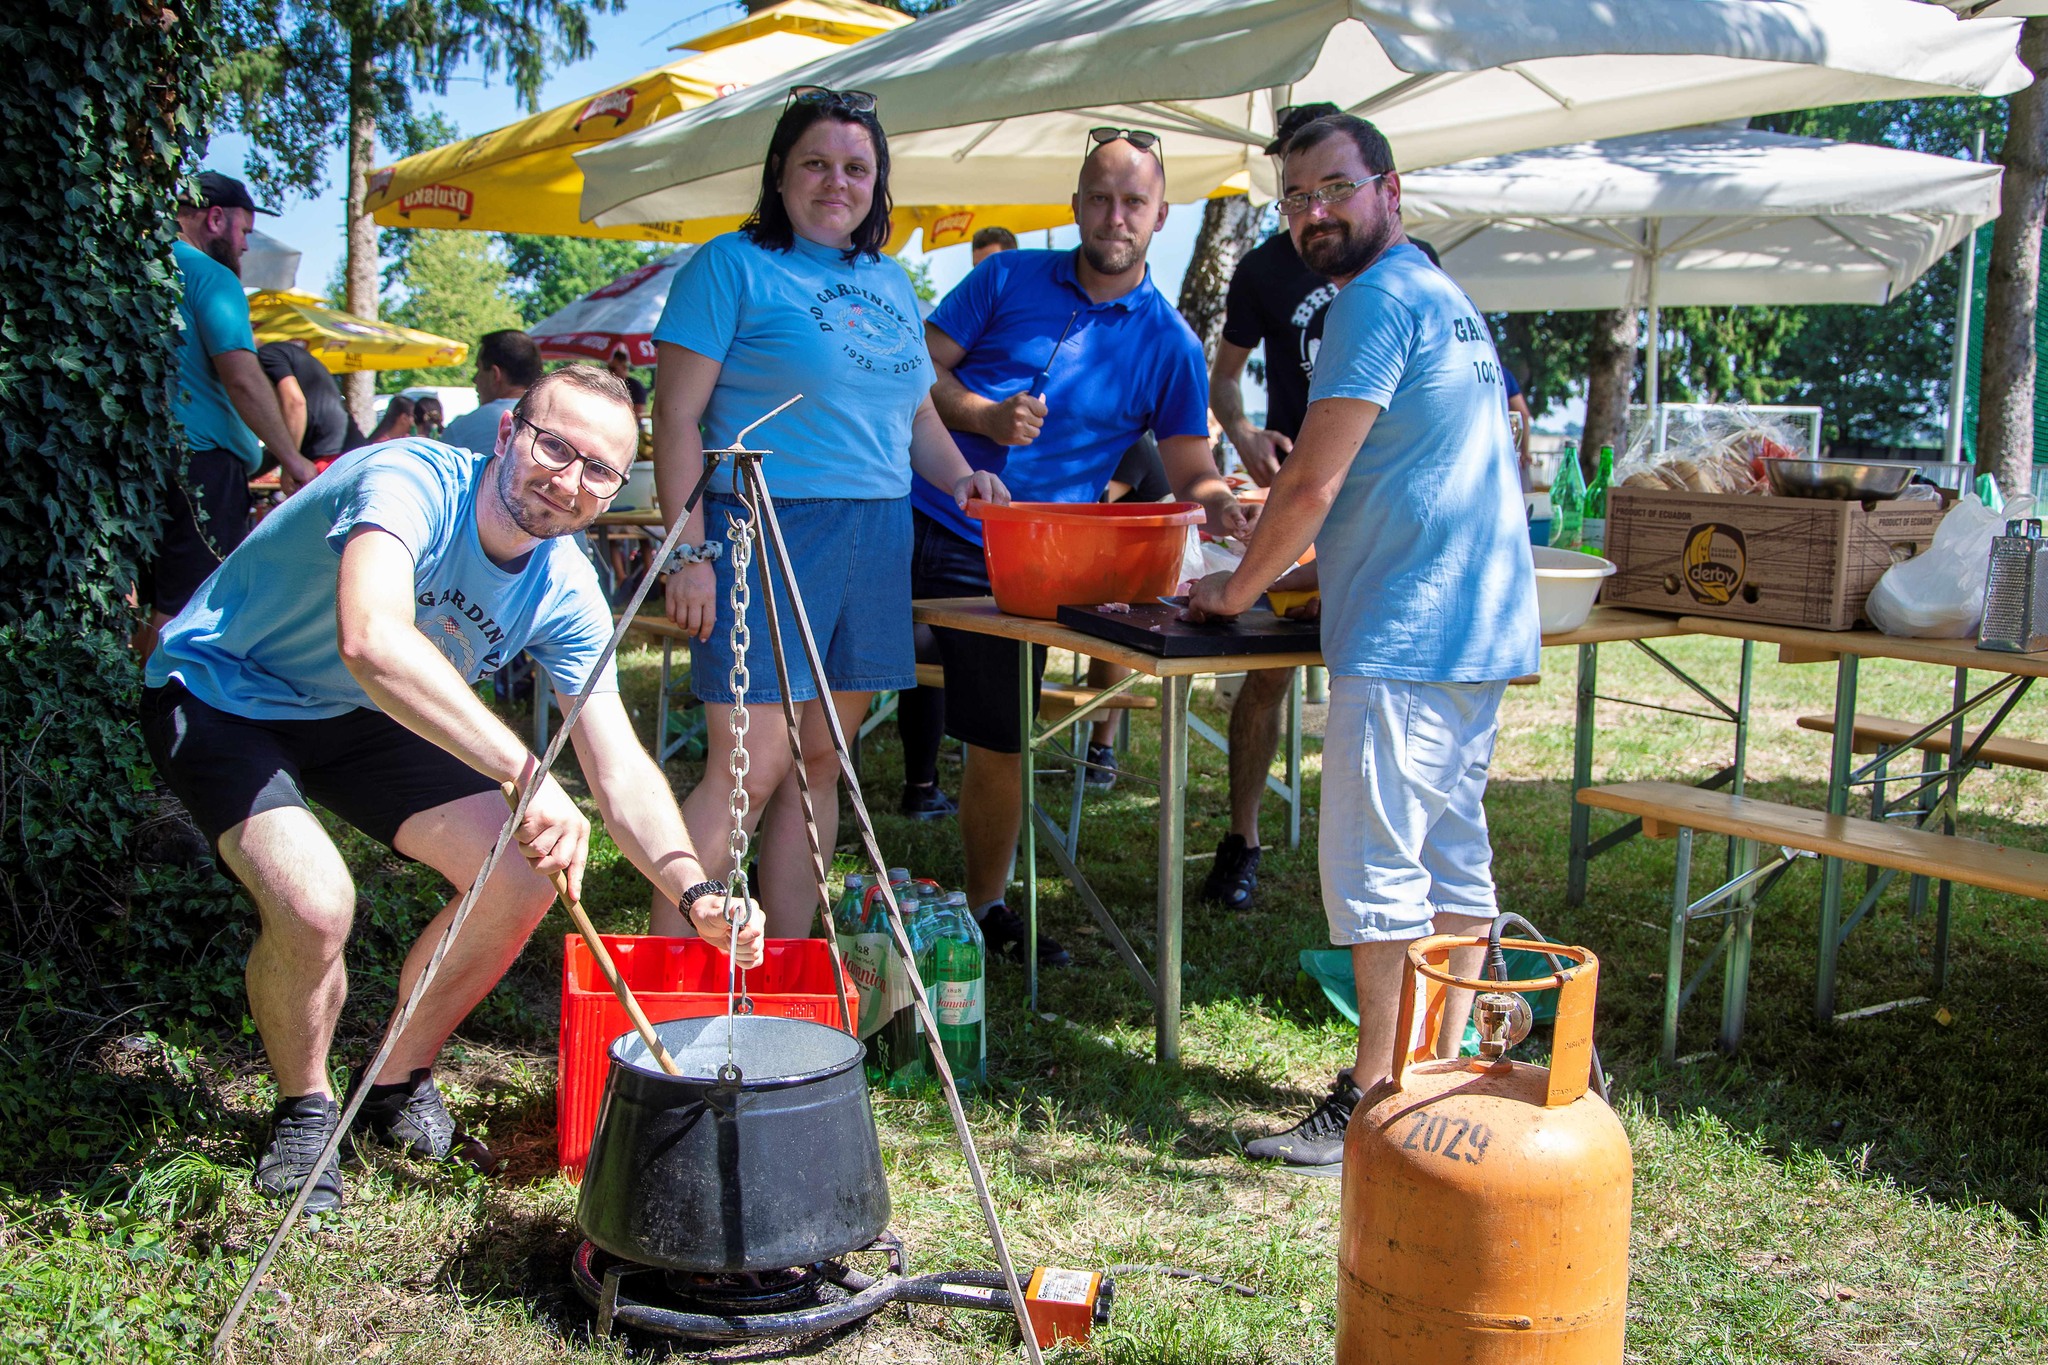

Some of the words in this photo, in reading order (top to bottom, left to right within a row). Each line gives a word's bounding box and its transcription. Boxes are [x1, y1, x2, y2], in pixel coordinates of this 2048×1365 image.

[842, 343, 876, 372] 1925.
[893, 355, 925, 374] 2025.
[1473, 360, 1496, 384] 100
[1615, 507, 1646, 518] PRODUCT
[1648, 509, 1657, 518] OF
[1659, 510, 1692, 521] ECUADOR
[1879, 518, 1902, 527] PRODUCT
[1903, 517, 1910, 527] OF
[1911, 517, 1933, 527] ECUADOR
[1691, 566, 1735, 587] derby
[1402, 1110, 1493, 1165] 2029
